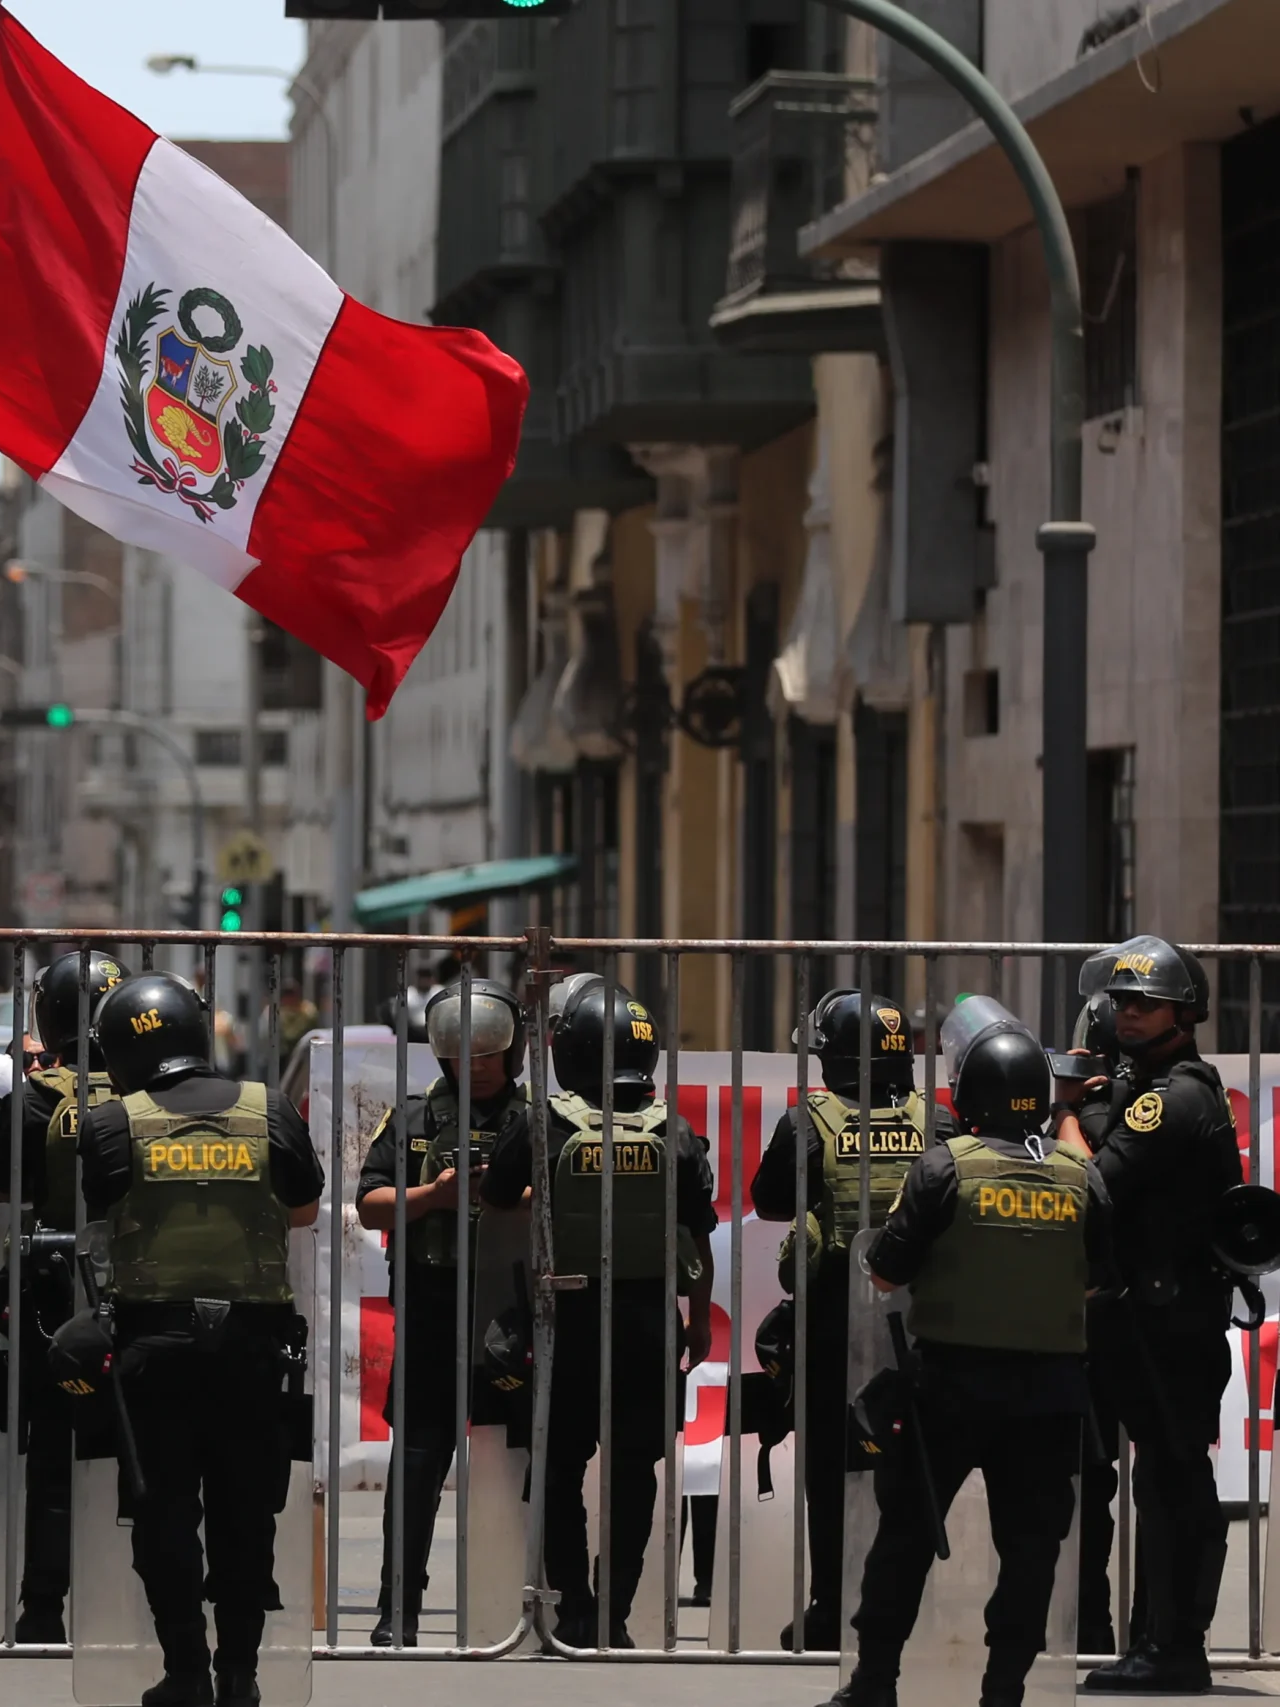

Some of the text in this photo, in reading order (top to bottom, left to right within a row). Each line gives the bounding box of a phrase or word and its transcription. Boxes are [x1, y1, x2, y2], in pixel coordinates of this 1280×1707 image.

[130, 1008, 162, 1035] USE
[630, 1020, 654, 1042] USE
[1011, 1098, 1036, 1111] USE
[150, 1142, 253, 1172] POLICIA
[581, 1144, 653, 1172] POICIA
[979, 1186, 1077, 1222] POLICIA
